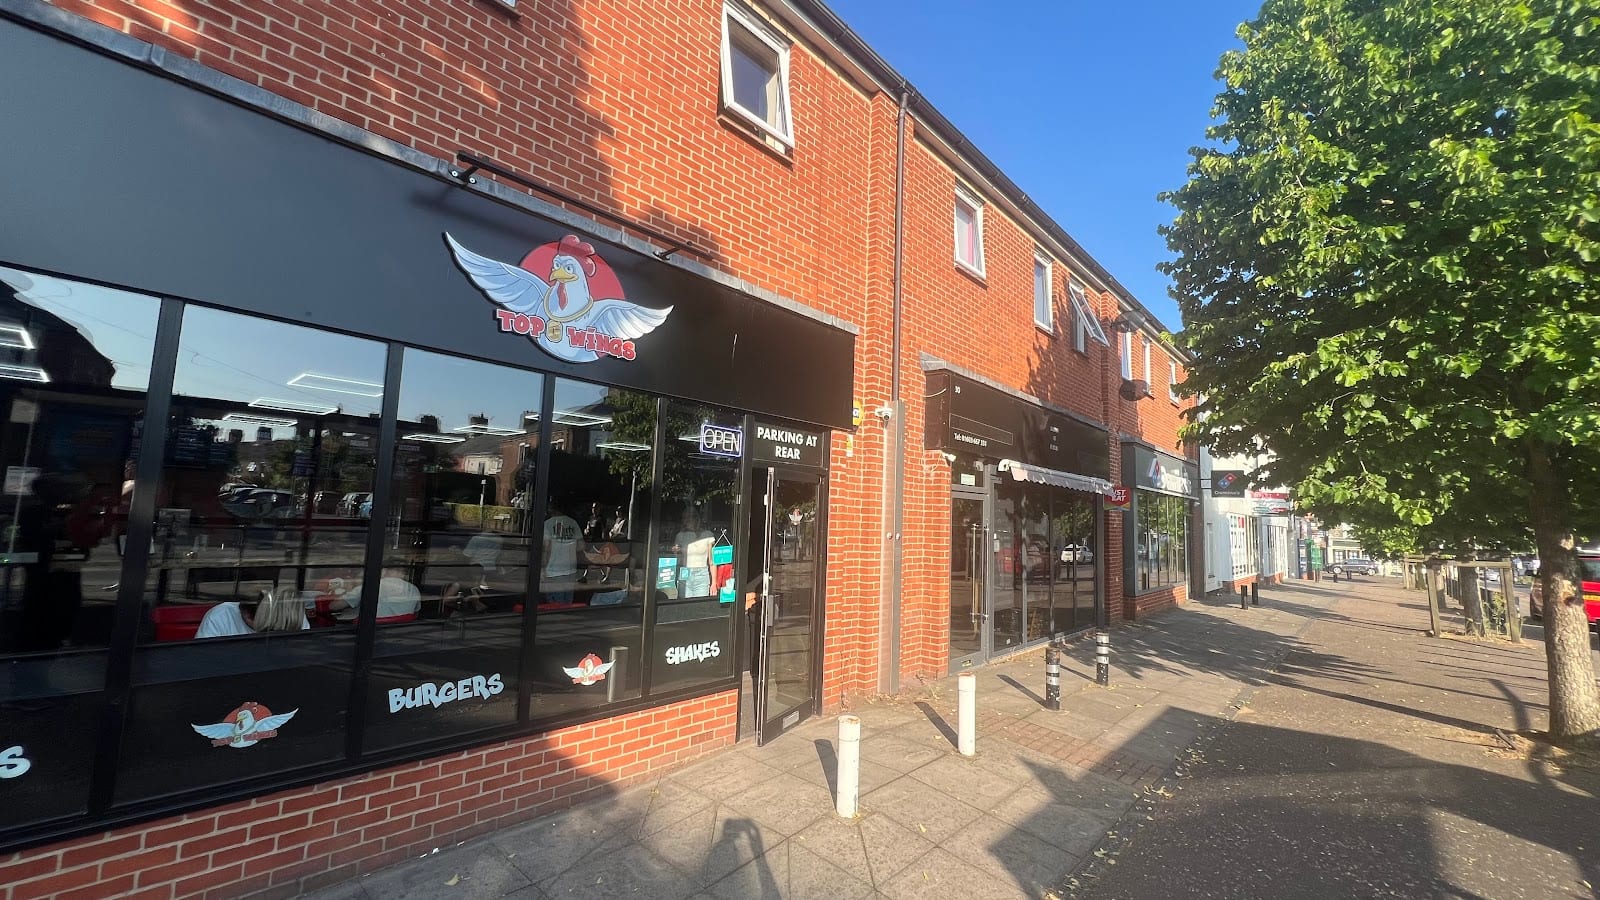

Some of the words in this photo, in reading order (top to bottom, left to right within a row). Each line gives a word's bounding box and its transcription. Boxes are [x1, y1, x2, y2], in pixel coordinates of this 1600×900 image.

[496, 309, 545, 339] TOP
[703, 428, 740, 453] OPEN
[757, 426, 804, 446] PARKING
[805, 435, 818, 448] AT
[775, 446, 801, 460] REAR
[665, 641, 721, 665] SHAKES
[388, 673, 504, 714] BURGERS
